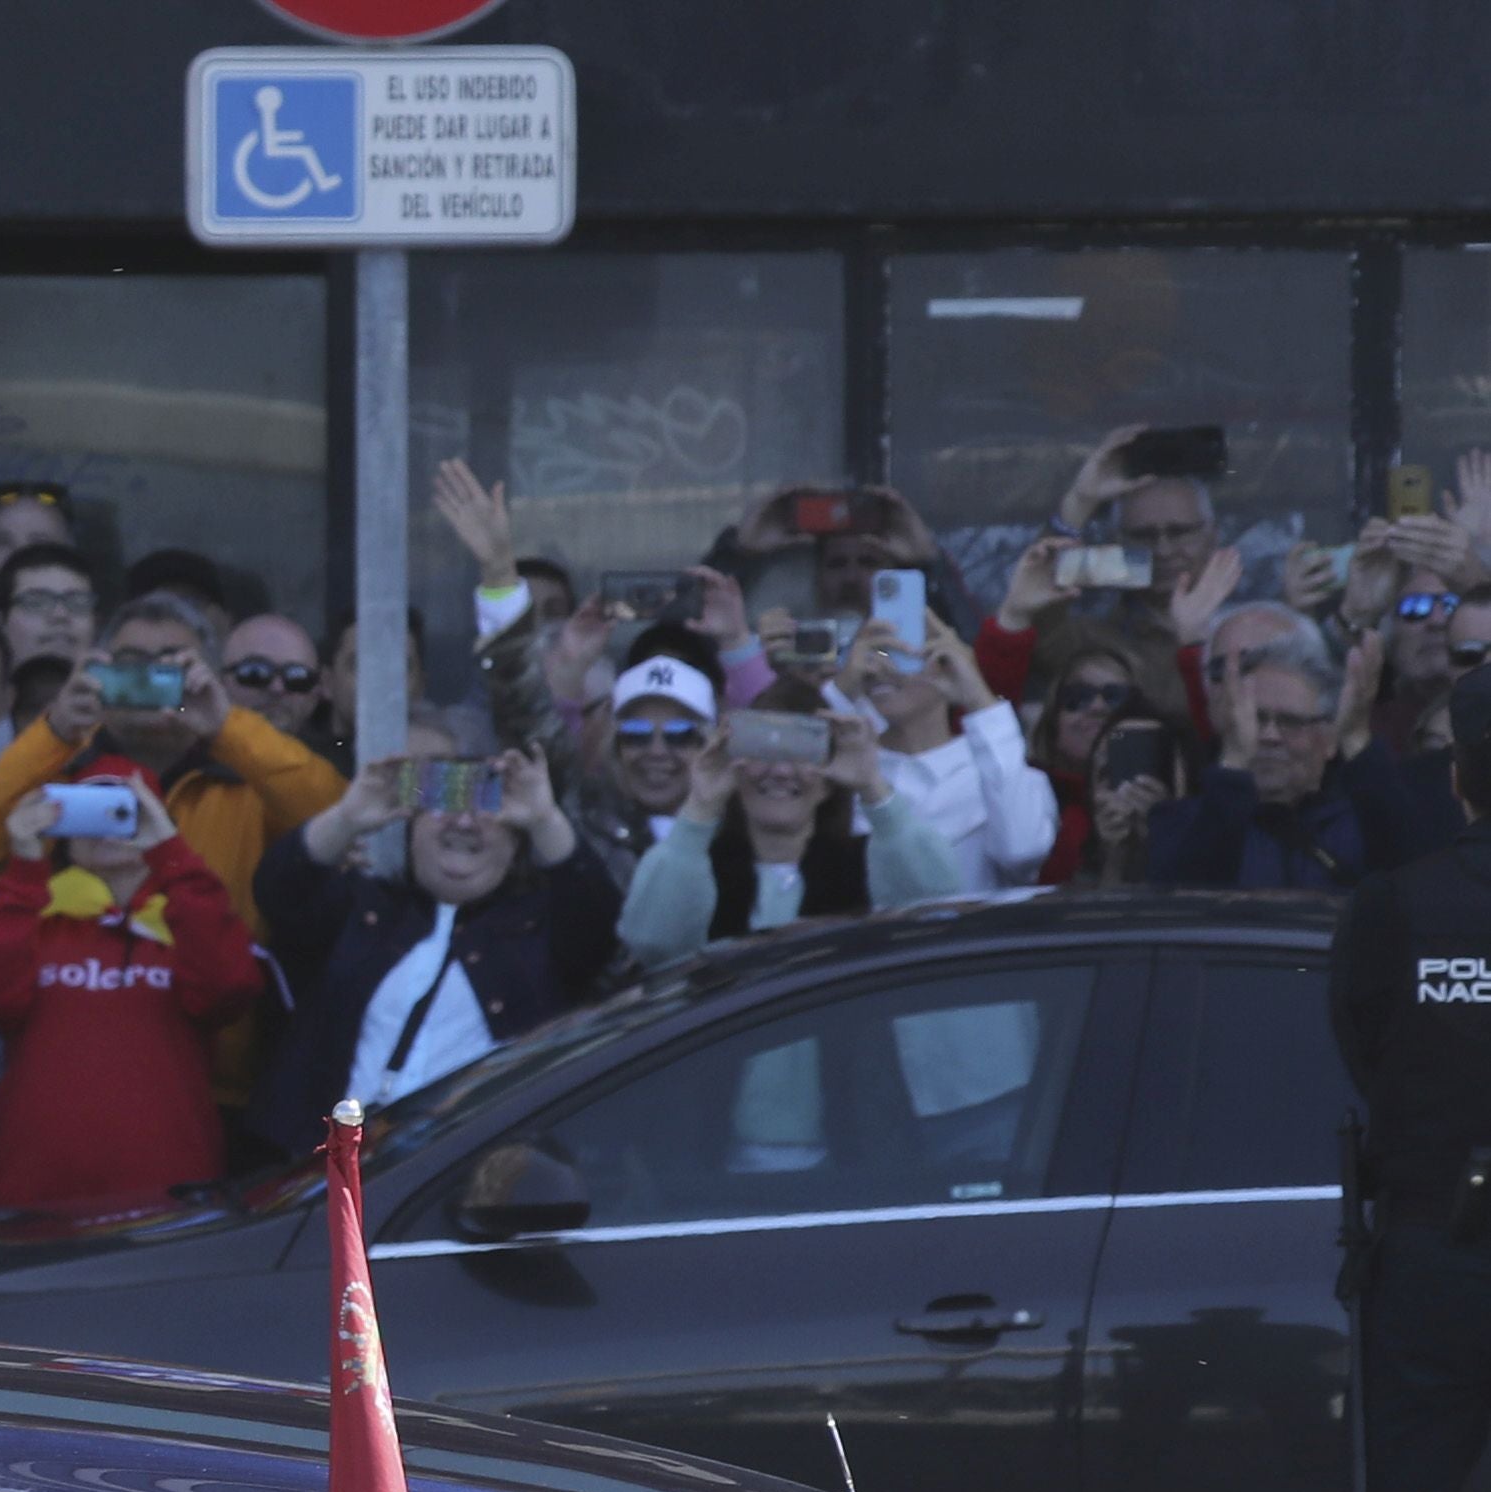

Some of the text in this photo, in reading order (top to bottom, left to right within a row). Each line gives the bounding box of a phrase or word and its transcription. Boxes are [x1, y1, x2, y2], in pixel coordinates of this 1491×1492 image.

[387, 75, 537, 101] EL USO INDEBIDO
[373, 115, 552, 140] PUEDE DAR LUGAR A
[370, 149, 556, 180] SANCIÓN Y RETIRADA
[401, 186, 524, 219] DEL VEHÍCULO
[38, 958, 173, 991] solera
[1418, 982, 1491, 1003] NAC
